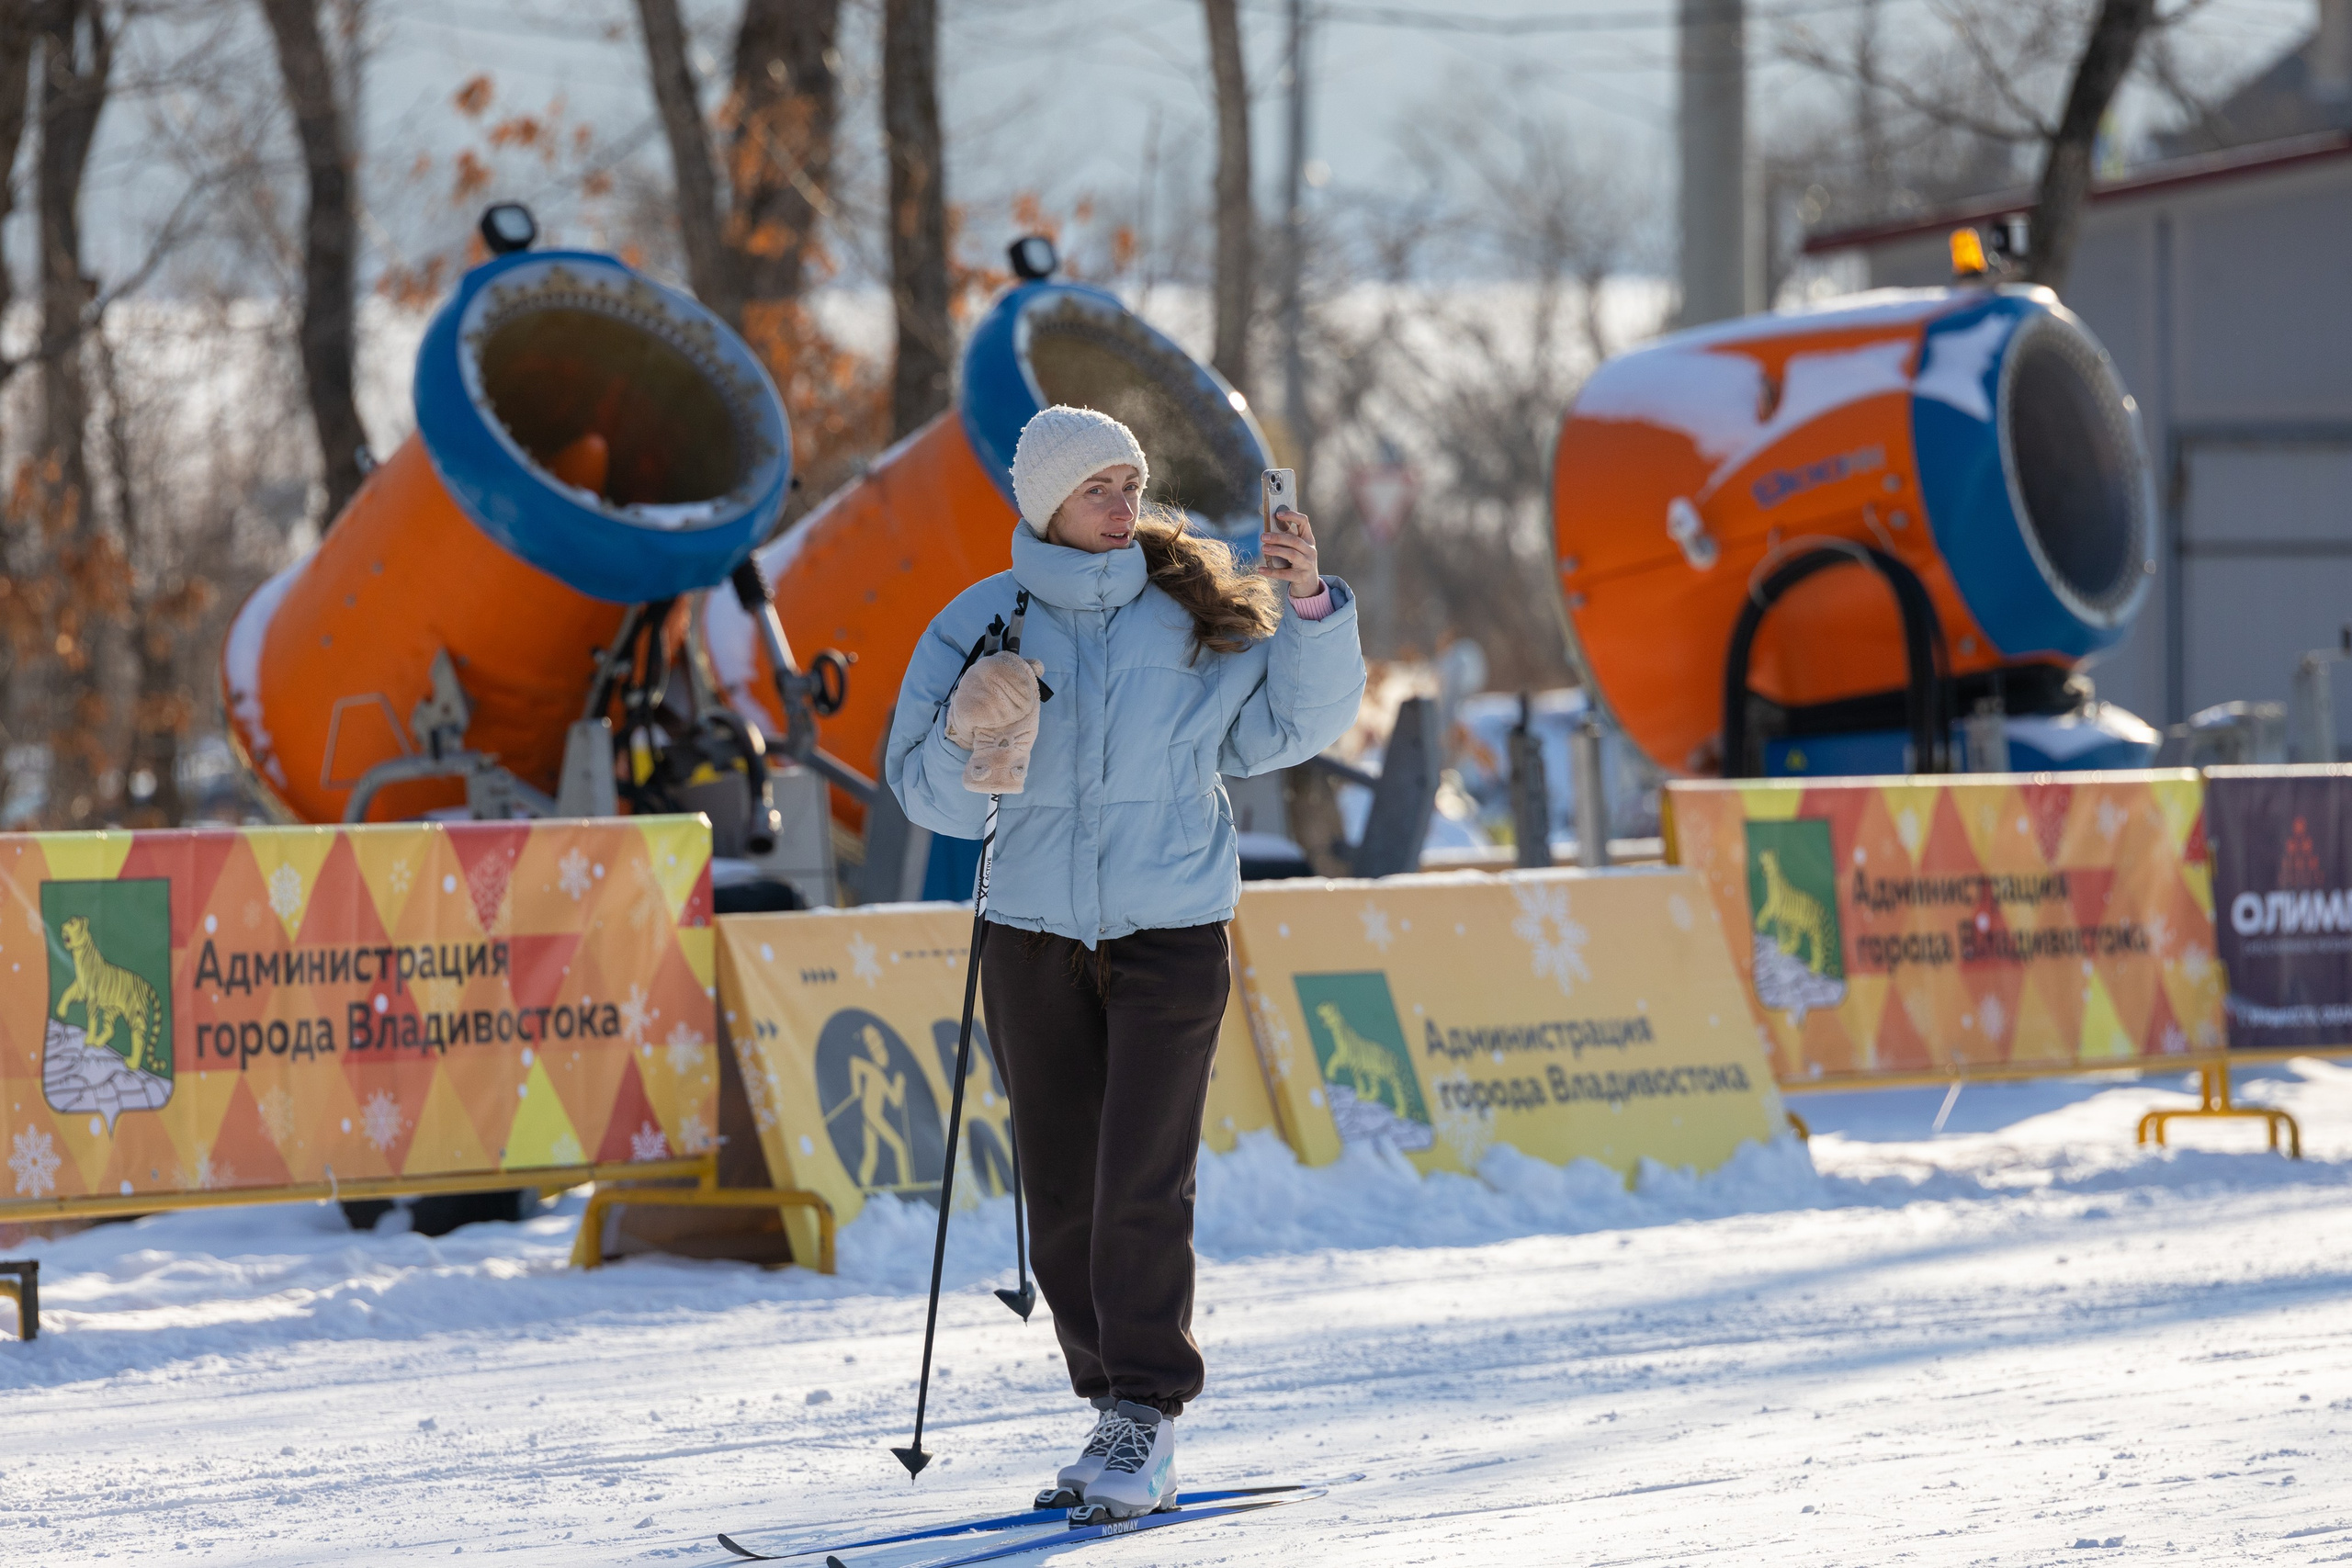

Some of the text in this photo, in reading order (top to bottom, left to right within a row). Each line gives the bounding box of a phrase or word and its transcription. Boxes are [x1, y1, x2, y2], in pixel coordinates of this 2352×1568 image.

[1852, 869, 2069, 911] Администрация
[195, 939, 510, 996] Администрация
[1856, 919, 2149, 976] города Владивостока
[197, 1001, 621, 1069] города Владивостока
[1425, 1015, 1654, 1060] Администрация
[1439, 1062, 1750, 1120] города Владивостока
[1102, 1519, 1139, 1537] NORDWAY
